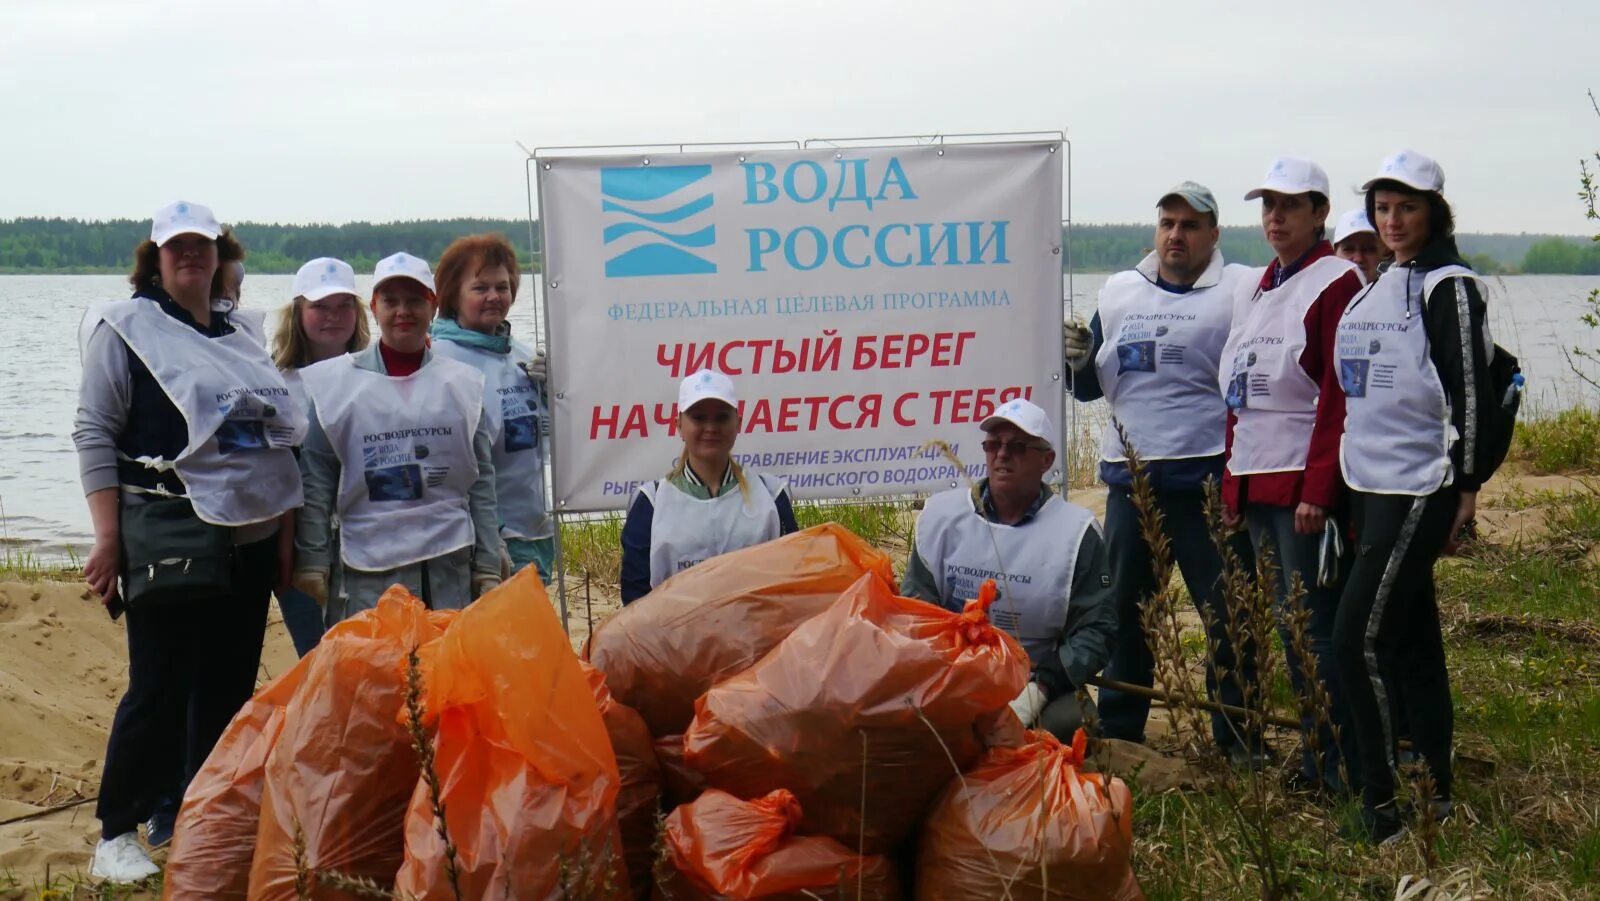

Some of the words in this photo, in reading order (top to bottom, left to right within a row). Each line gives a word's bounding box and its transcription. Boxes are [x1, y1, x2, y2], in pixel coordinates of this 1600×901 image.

[739, 156, 919, 212] ВОДА
[744, 220, 1011, 272] РОССИИ
[607, 297, 768, 322] ФЕДЕРАЛЬНАЯ
[776, 293, 875, 316] ЦЕЛЕВАЯ
[883, 288, 1011, 310] ПРОГРАММА
[656, 329, 843, 378] ЧИСТЫЙ
[852, 331, 976, 371] БЕРЕГ
[363, 427, 452, 443] РОСВОДРЕСУРСЫ
[589, 393, 883, 440] НАЧАЕТСЯ
[893, 392, 919, 427] С
[732, 449, 829, 468] ПРАВЛЕНИЕ
